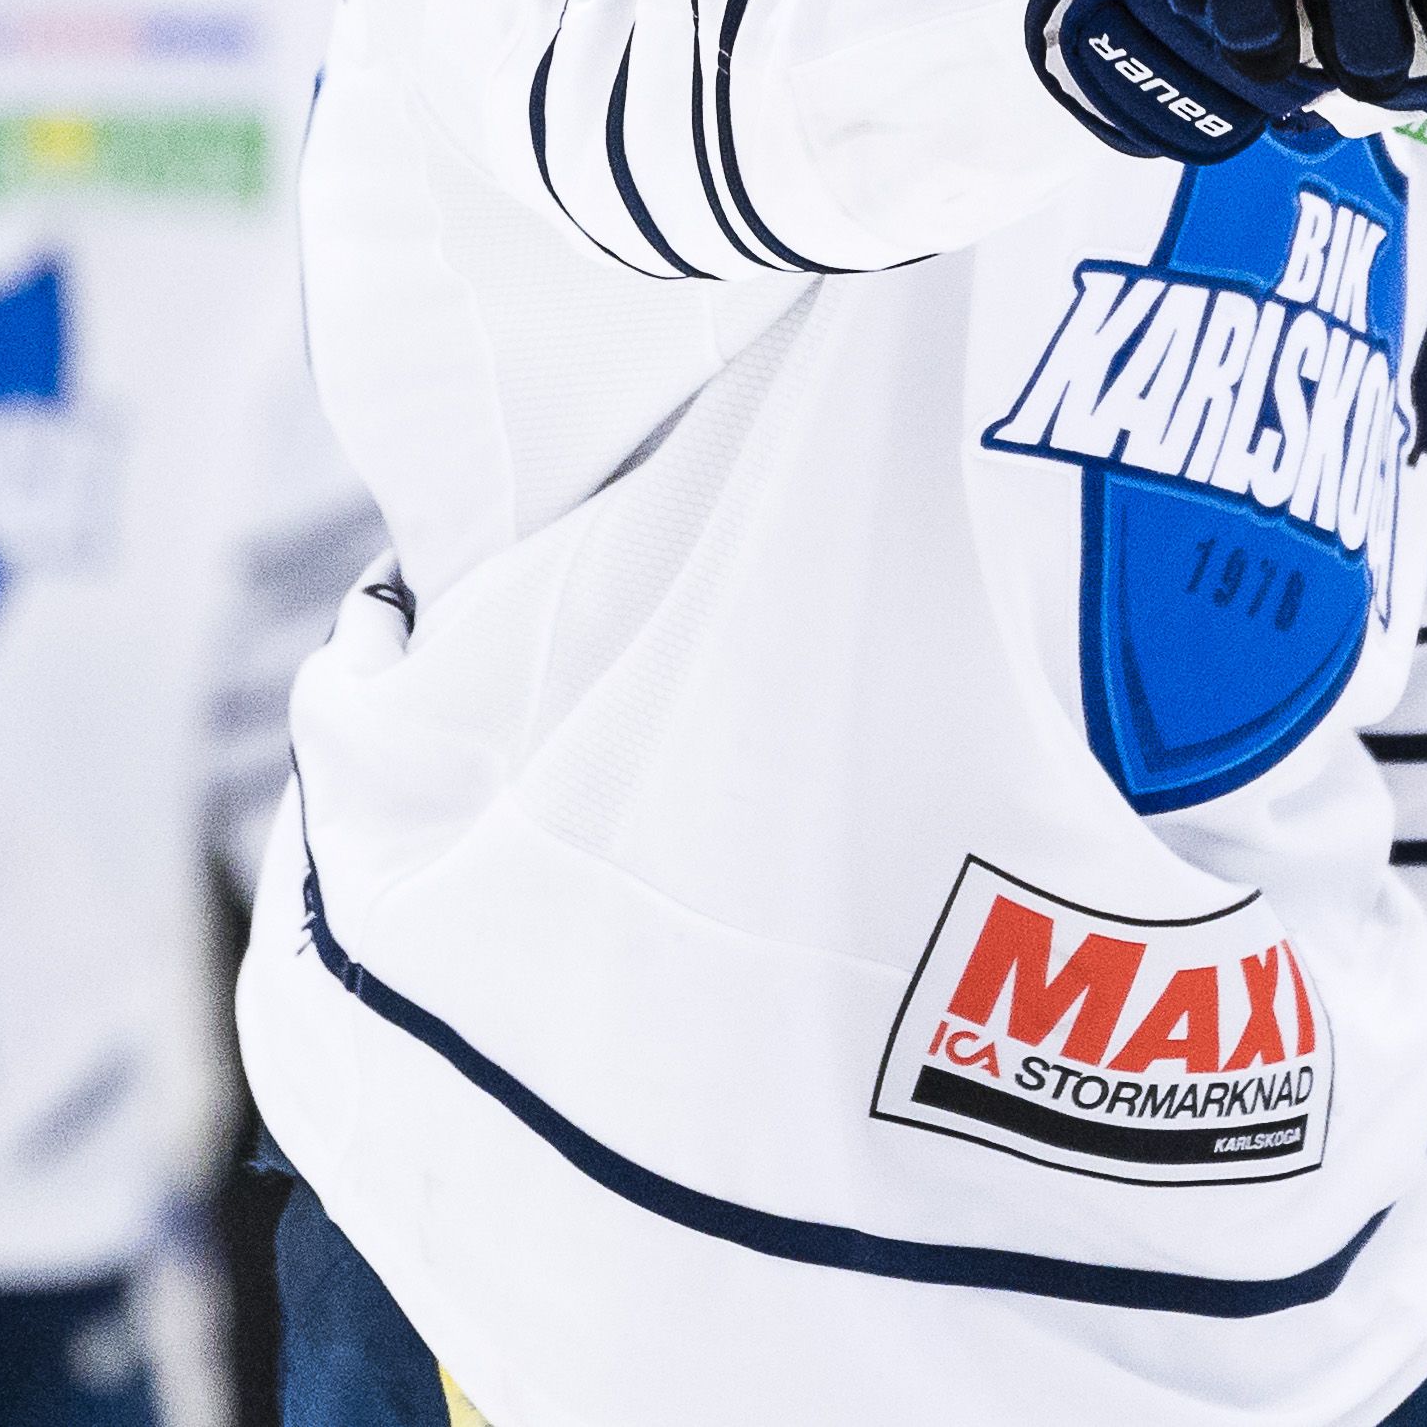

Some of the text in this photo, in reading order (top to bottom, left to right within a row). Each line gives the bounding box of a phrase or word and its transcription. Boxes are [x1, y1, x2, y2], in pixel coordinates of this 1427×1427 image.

[1088, 33, 1233, 138] BAUER
[1284, 190, 1388, 336] BIK
[988, 269, 1408, 622] KARLSKO
[947, 894, 1316, 1074] MAXI
[928, 1021, 1315, 1120] ICA STORMARKNAD
[1212, 1126, 1303, 1154] KARLSKOGA
